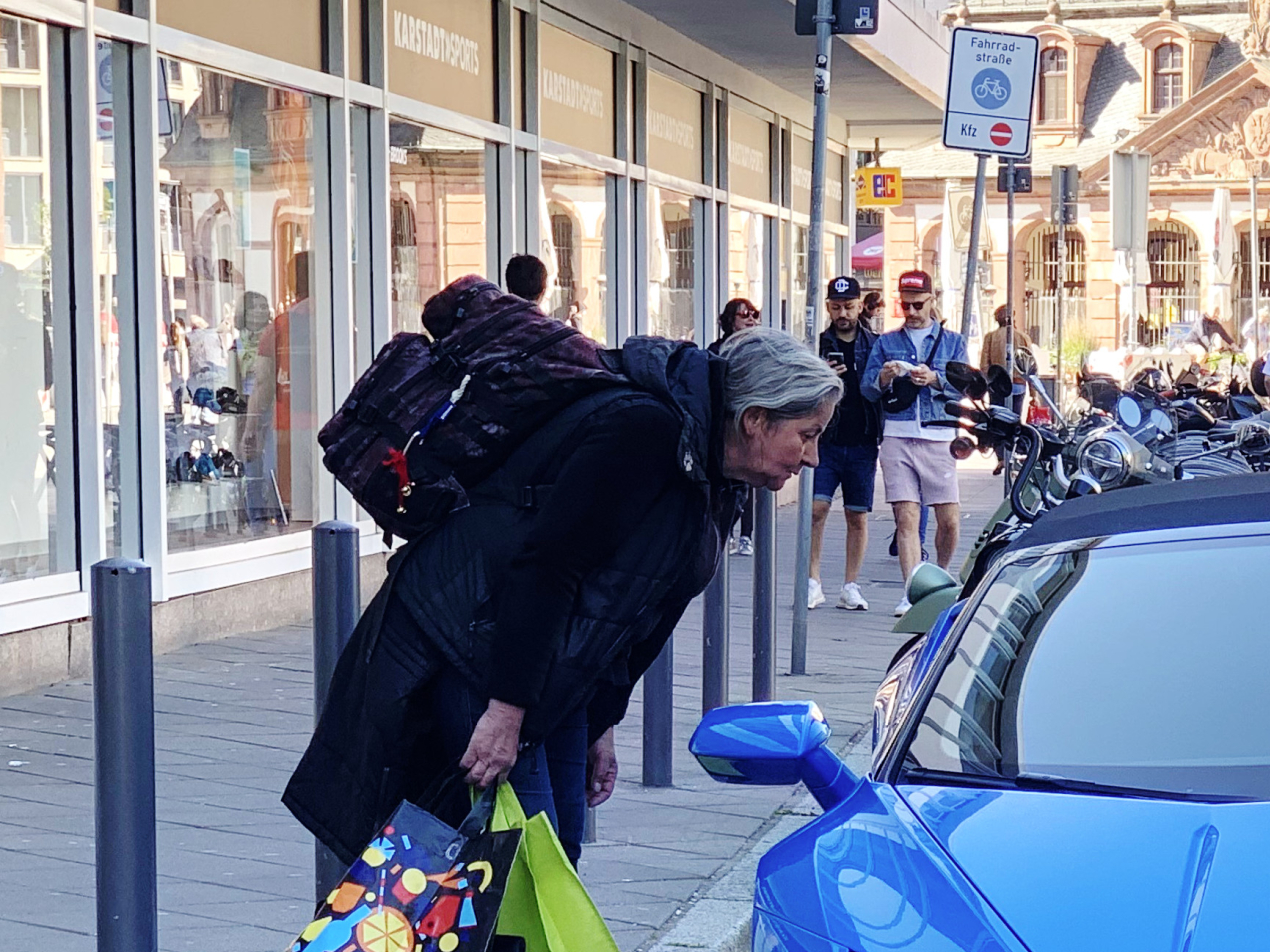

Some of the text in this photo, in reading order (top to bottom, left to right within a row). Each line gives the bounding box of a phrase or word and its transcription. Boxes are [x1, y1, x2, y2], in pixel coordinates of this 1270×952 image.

[971, 37, 1021, 52] Fahrrad-
[975, 53, 1013, 65] straße
[960, 123, 977, 137] Kfz
